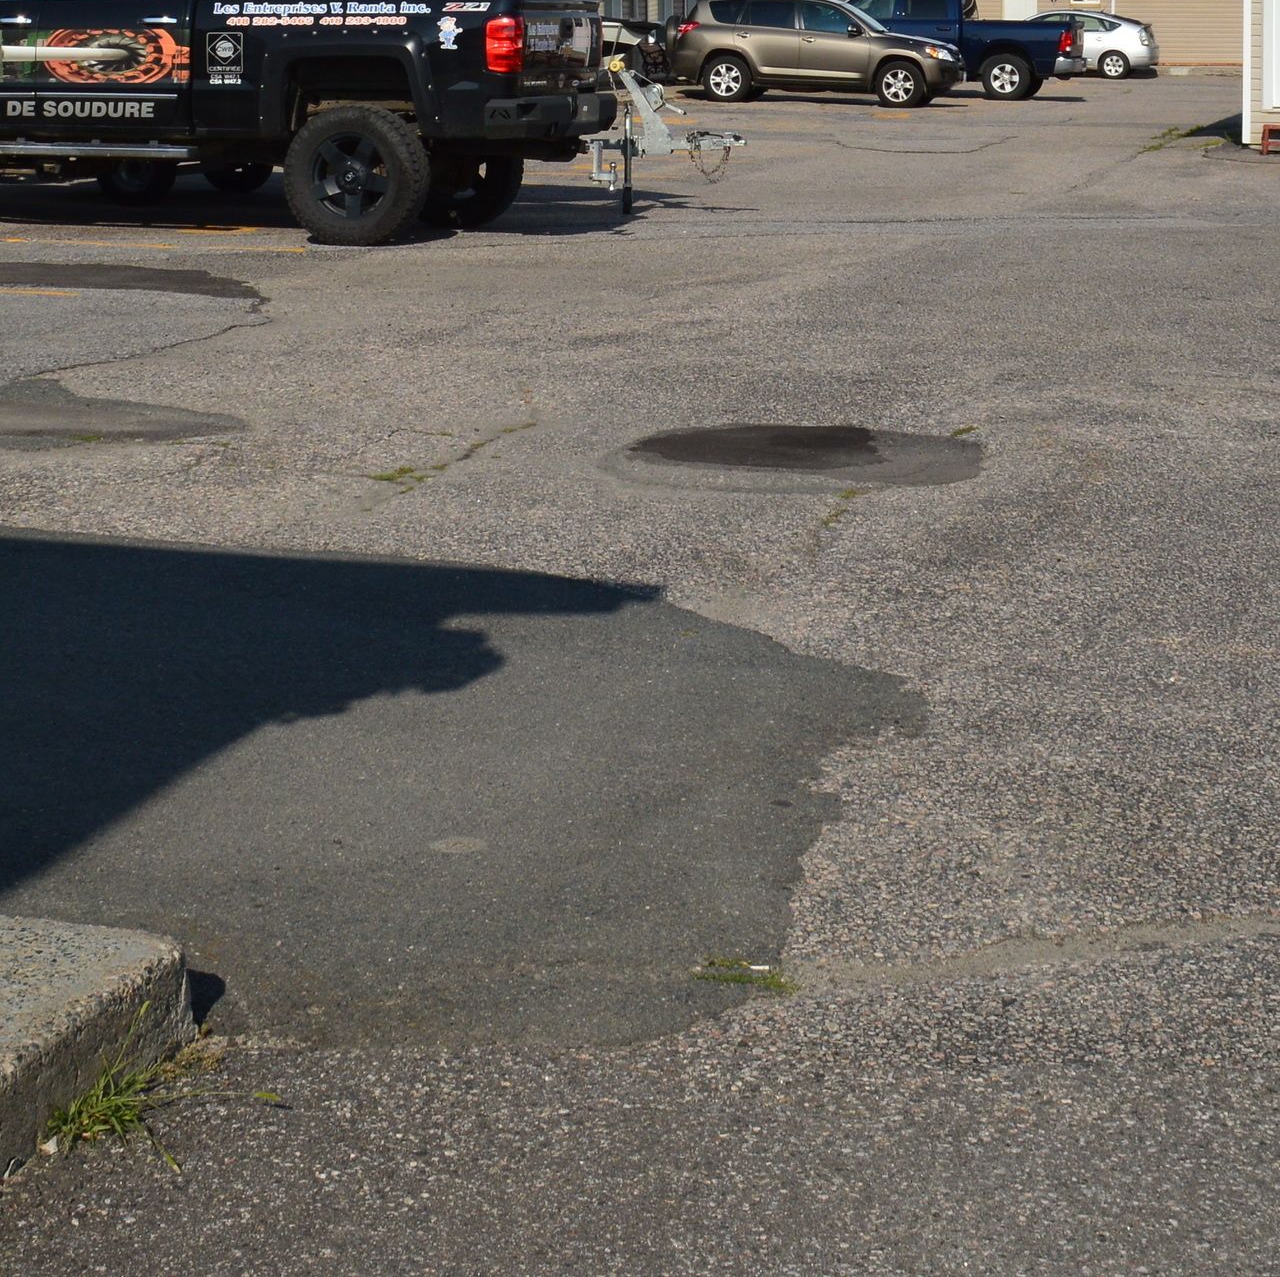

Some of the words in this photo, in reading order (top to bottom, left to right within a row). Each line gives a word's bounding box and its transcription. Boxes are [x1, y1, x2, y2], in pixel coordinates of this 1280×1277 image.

[213, 2, 240, 14] Les
[242, 1, 327, 16] Entreprises
[330, 1, 344, 14] V.
[346, 1, 396, 14] Ranta
[399, 0, 431, 14] inc.
[441, 1, 491, 12] Z71
[6, 100, 36, 117] DE
[43, 101, 155, 118] SOUDURE
